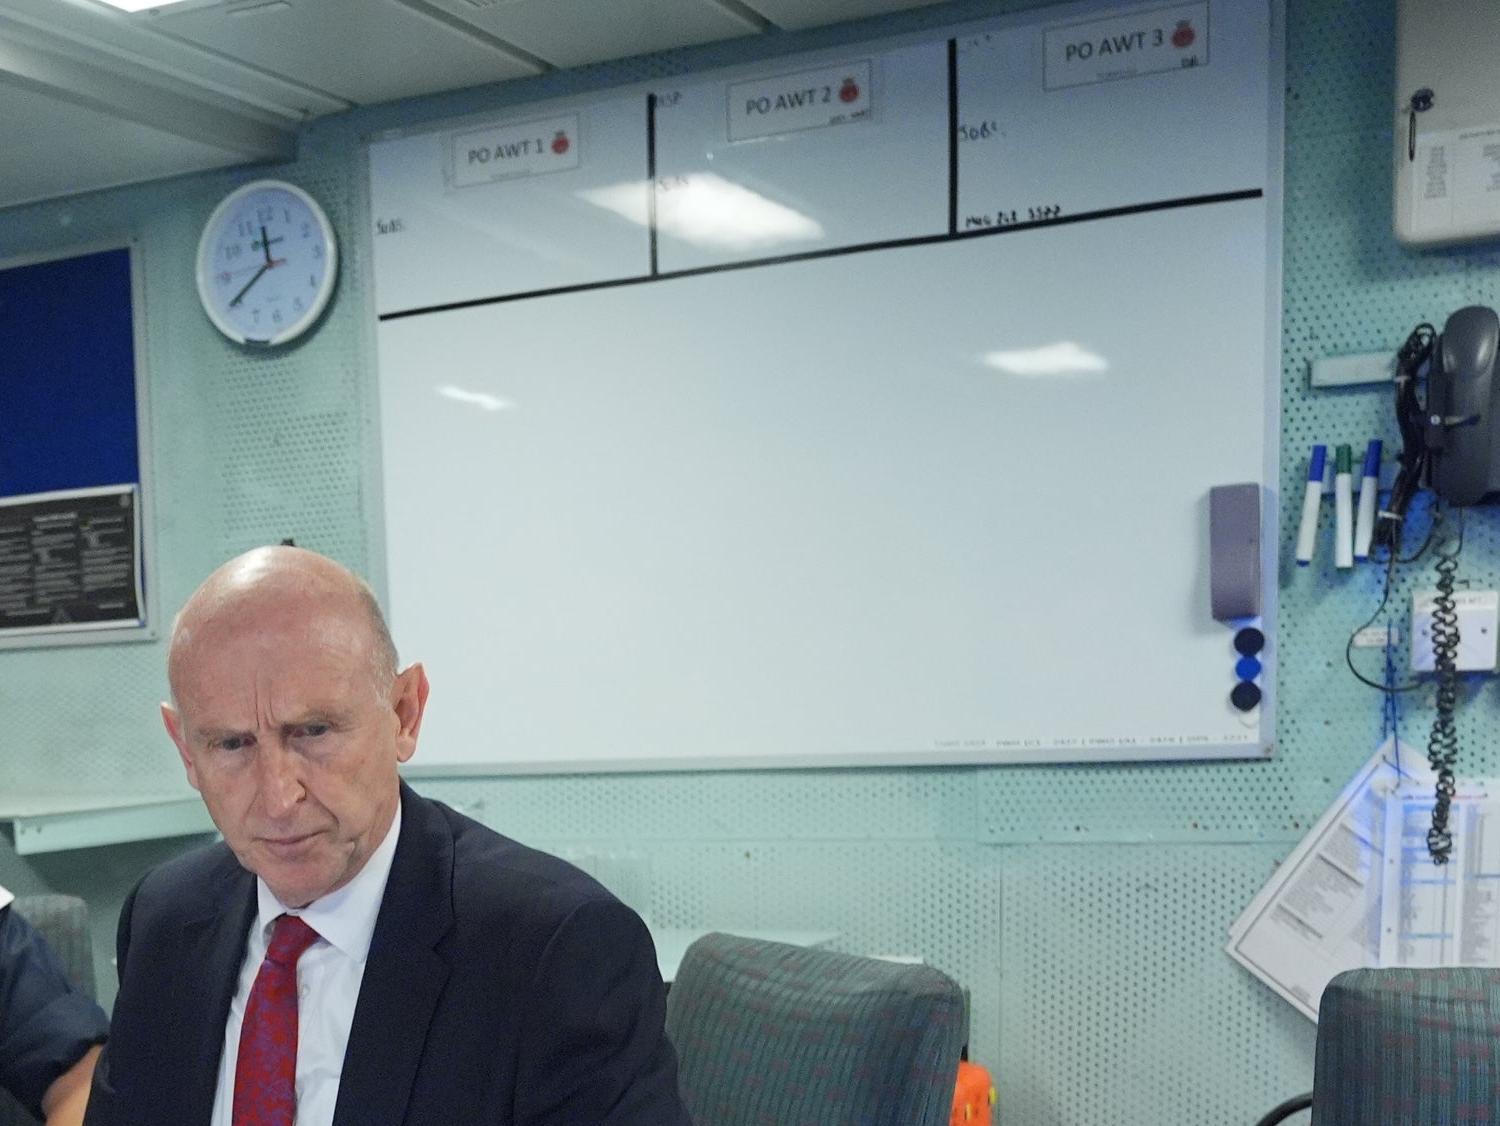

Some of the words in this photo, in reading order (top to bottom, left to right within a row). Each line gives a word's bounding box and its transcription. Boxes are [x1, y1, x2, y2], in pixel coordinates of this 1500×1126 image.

[1065, 42, 1093, 62] PO
[1099, 31, 1146, 56] AWT
[1152, 29, 1163, 47] 3
[746, 97, 771, 116] PO
[775, 88, 816, 111] AWT
[822, 86, 831, 103] 2
[468, 147, 491, 165] PO
[494, 139, 531, 160] AWT
[536, 139, 544, 154] 1
